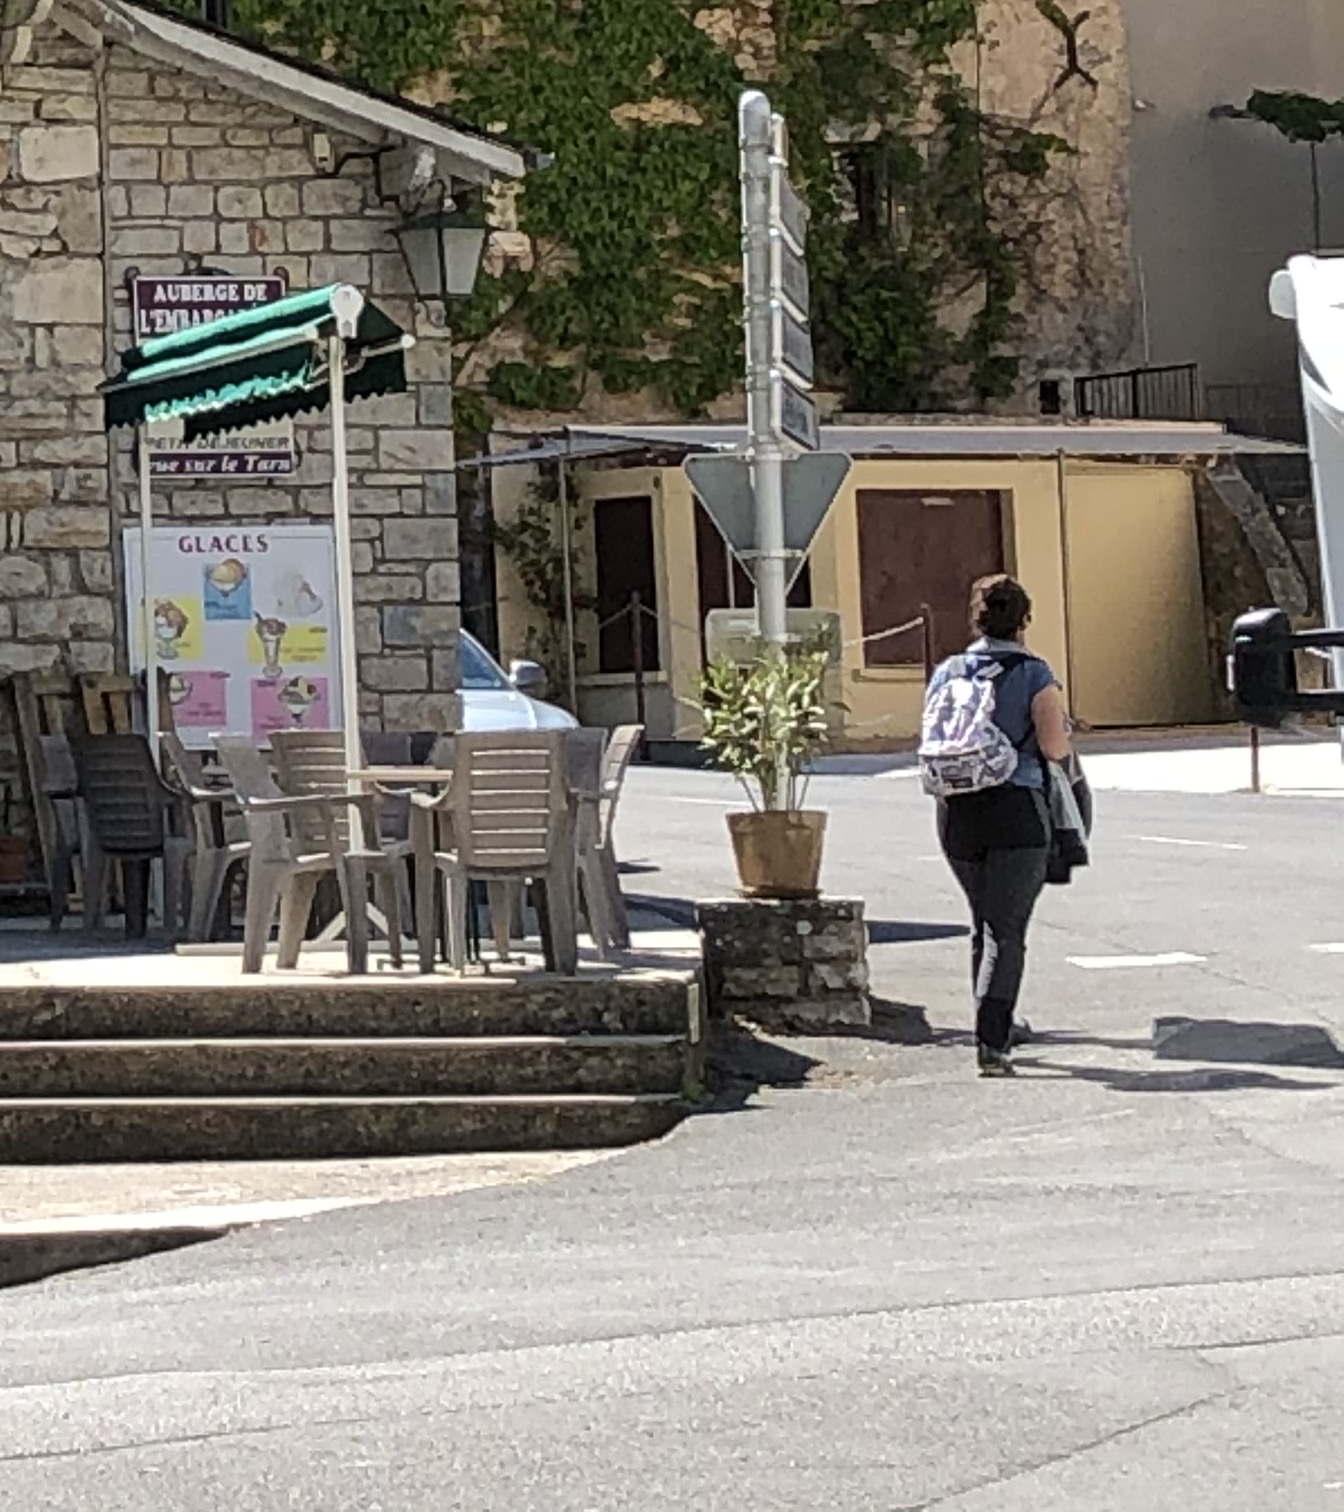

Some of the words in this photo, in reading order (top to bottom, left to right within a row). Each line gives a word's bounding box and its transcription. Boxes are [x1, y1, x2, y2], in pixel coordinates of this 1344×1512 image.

[153, 284, 240, 303] AUBERGE
[243, 284, 268, 301] DE
[184, 459, 217, 473] sur
[221, 455, 239, 473] le
[244, 455, 290, 473] Tarn
[178, 534, 269, 553] GLACES
